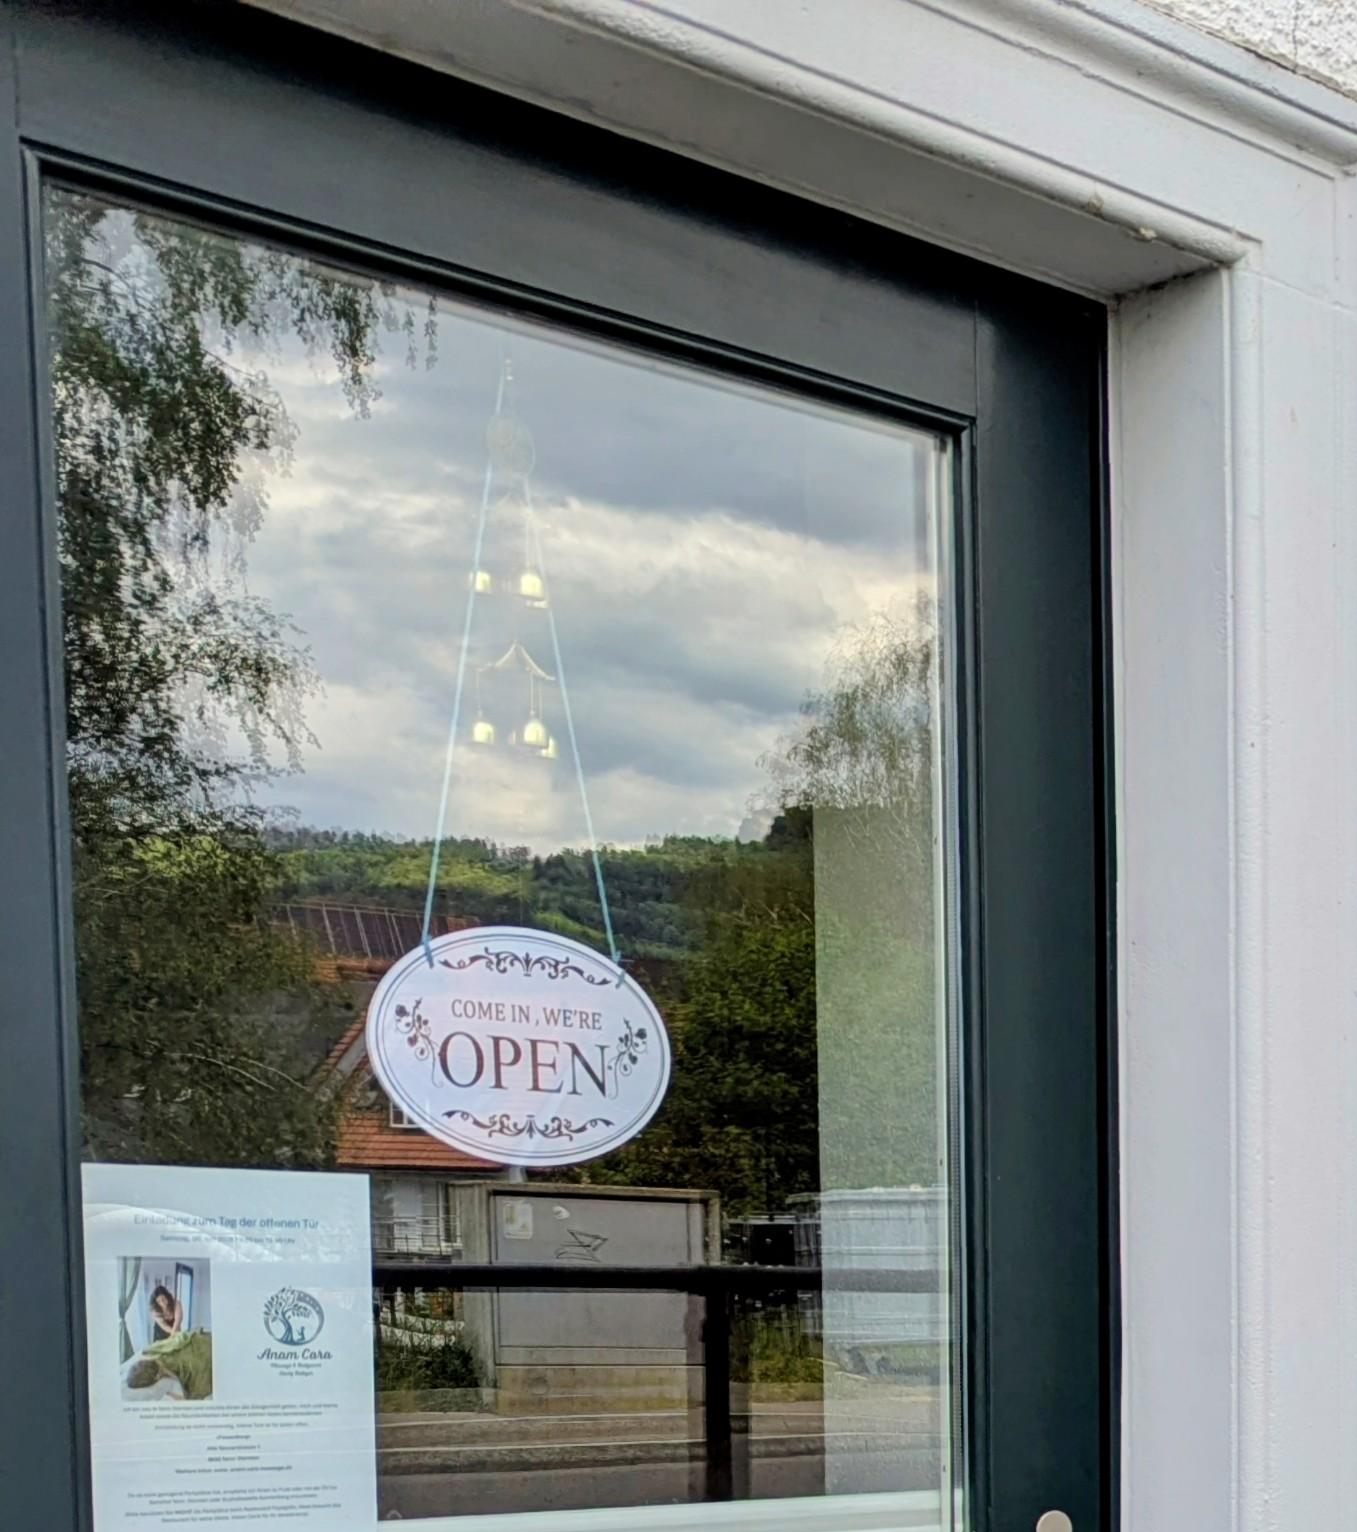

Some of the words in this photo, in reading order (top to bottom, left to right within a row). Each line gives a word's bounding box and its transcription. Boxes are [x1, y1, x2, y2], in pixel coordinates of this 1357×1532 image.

[450, 999, 505, 1023] COME
[542, 1008, 603, 1031] WE'RE
[438, 1030, 611, 1099] OPEN
[218, 1215, 238, 1229] Tag
[239, 1217, 257, 1228] der
[256, 1346, 300, 1361] Anam
[301, 1347, 334, 1361] Cara
